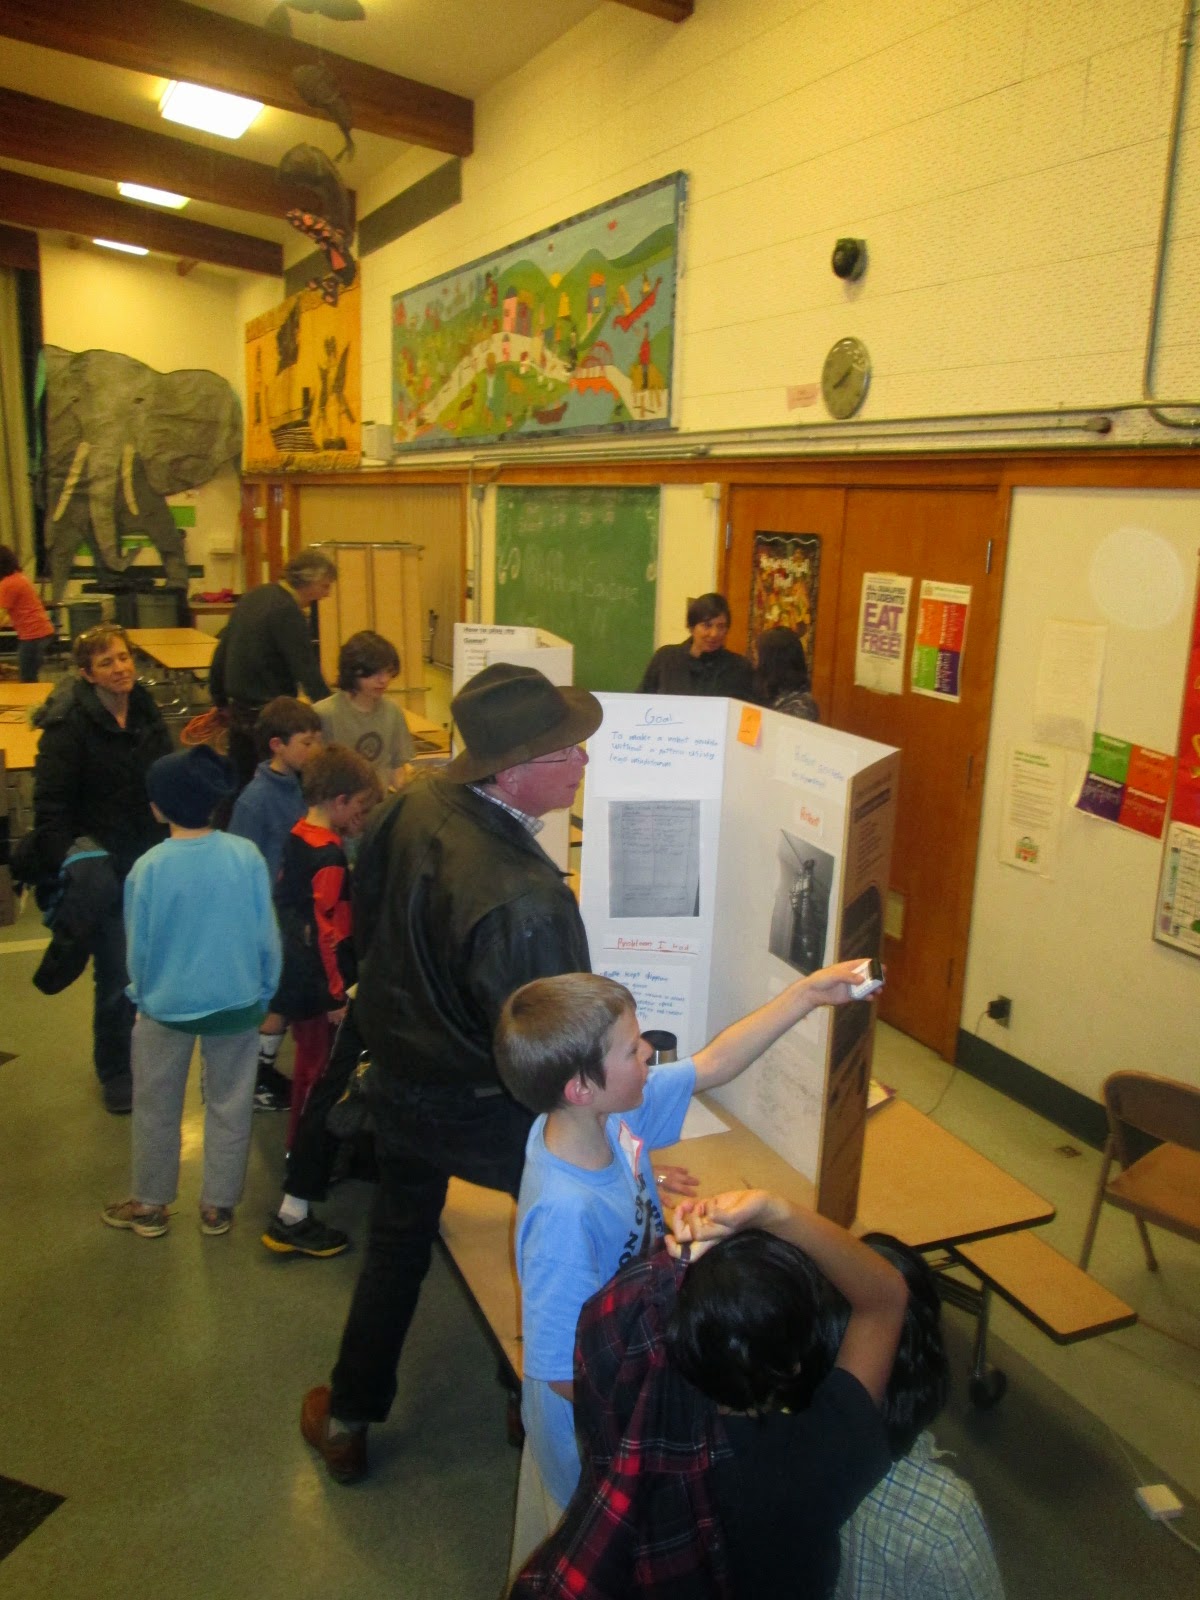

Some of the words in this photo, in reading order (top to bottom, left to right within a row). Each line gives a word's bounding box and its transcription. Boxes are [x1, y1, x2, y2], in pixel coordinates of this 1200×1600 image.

[864, 602, 903, 633] EAT
[861, 633, 900, 654] FREE
[644, 708, 673, 725] Goal
[611, 731, 623, 740] To
[629, 733, 651, 741] make
